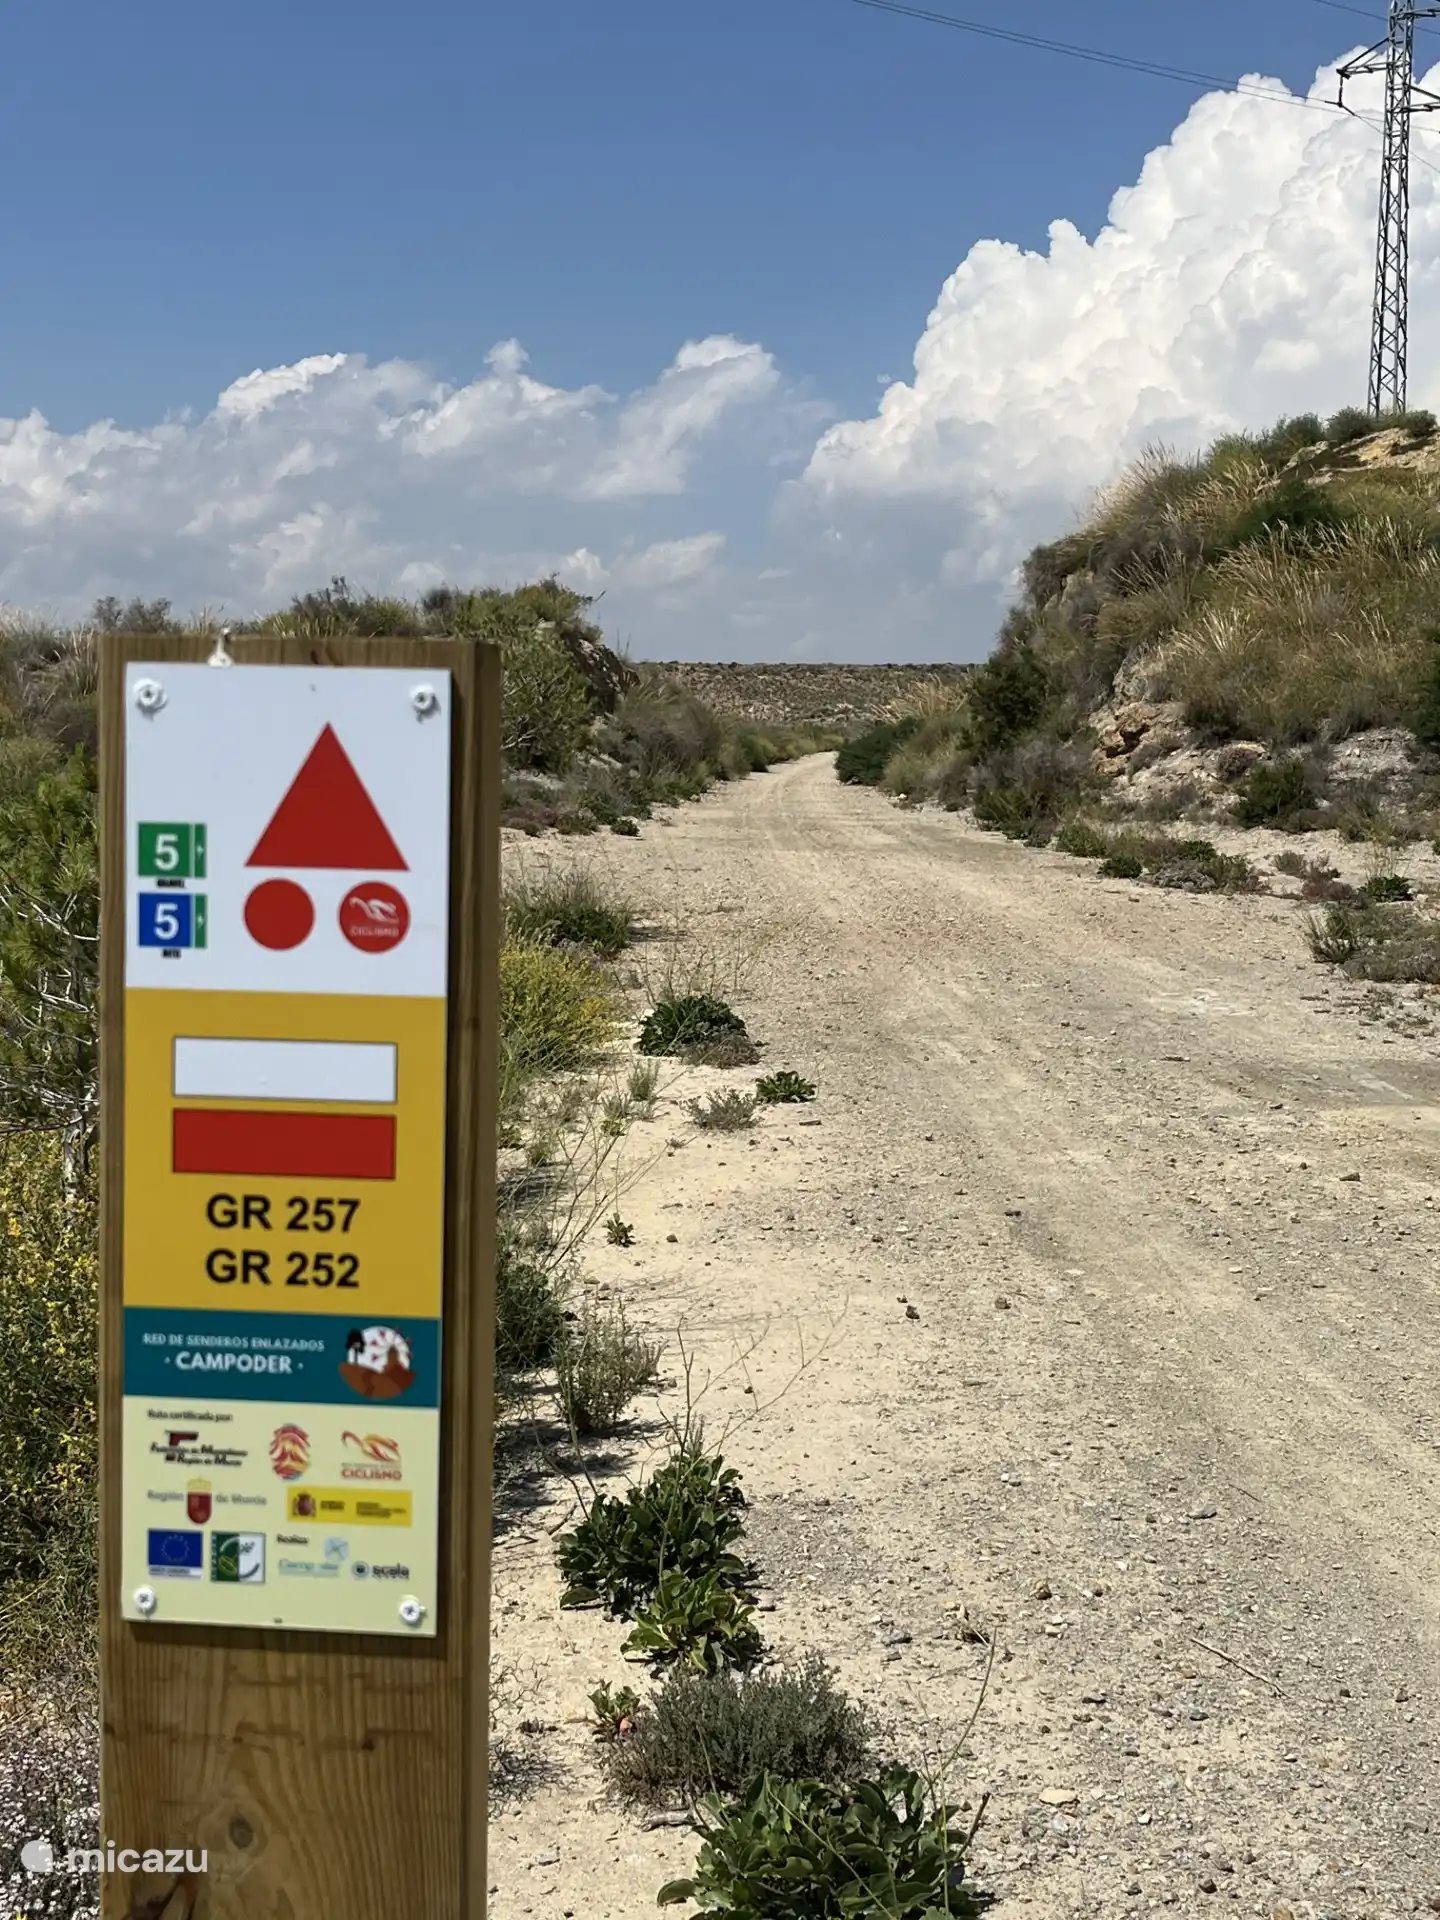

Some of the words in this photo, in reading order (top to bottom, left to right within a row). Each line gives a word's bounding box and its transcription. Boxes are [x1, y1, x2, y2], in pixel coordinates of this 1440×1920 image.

[154, 833, 179, 871] 5
[154, 902, 179, 940] 5
[206, 1193, 272, 1231] GR
[286, 1196, 361, 1234] 257
[206, 1248, 272, 1285] GR
[285, 1251, 360, 1289] 252
[142, 1333, 166, 1345] RED
[168, 1334, 183, 1346] DE
[186, 1335, 248, 1348] SENDEROS
[251, 1337, 325, 1351] ENLAZADOS
[175, 1351, 293, 1374] CAMPODER
[341, 1467, 402, 1481] CICLISMO
